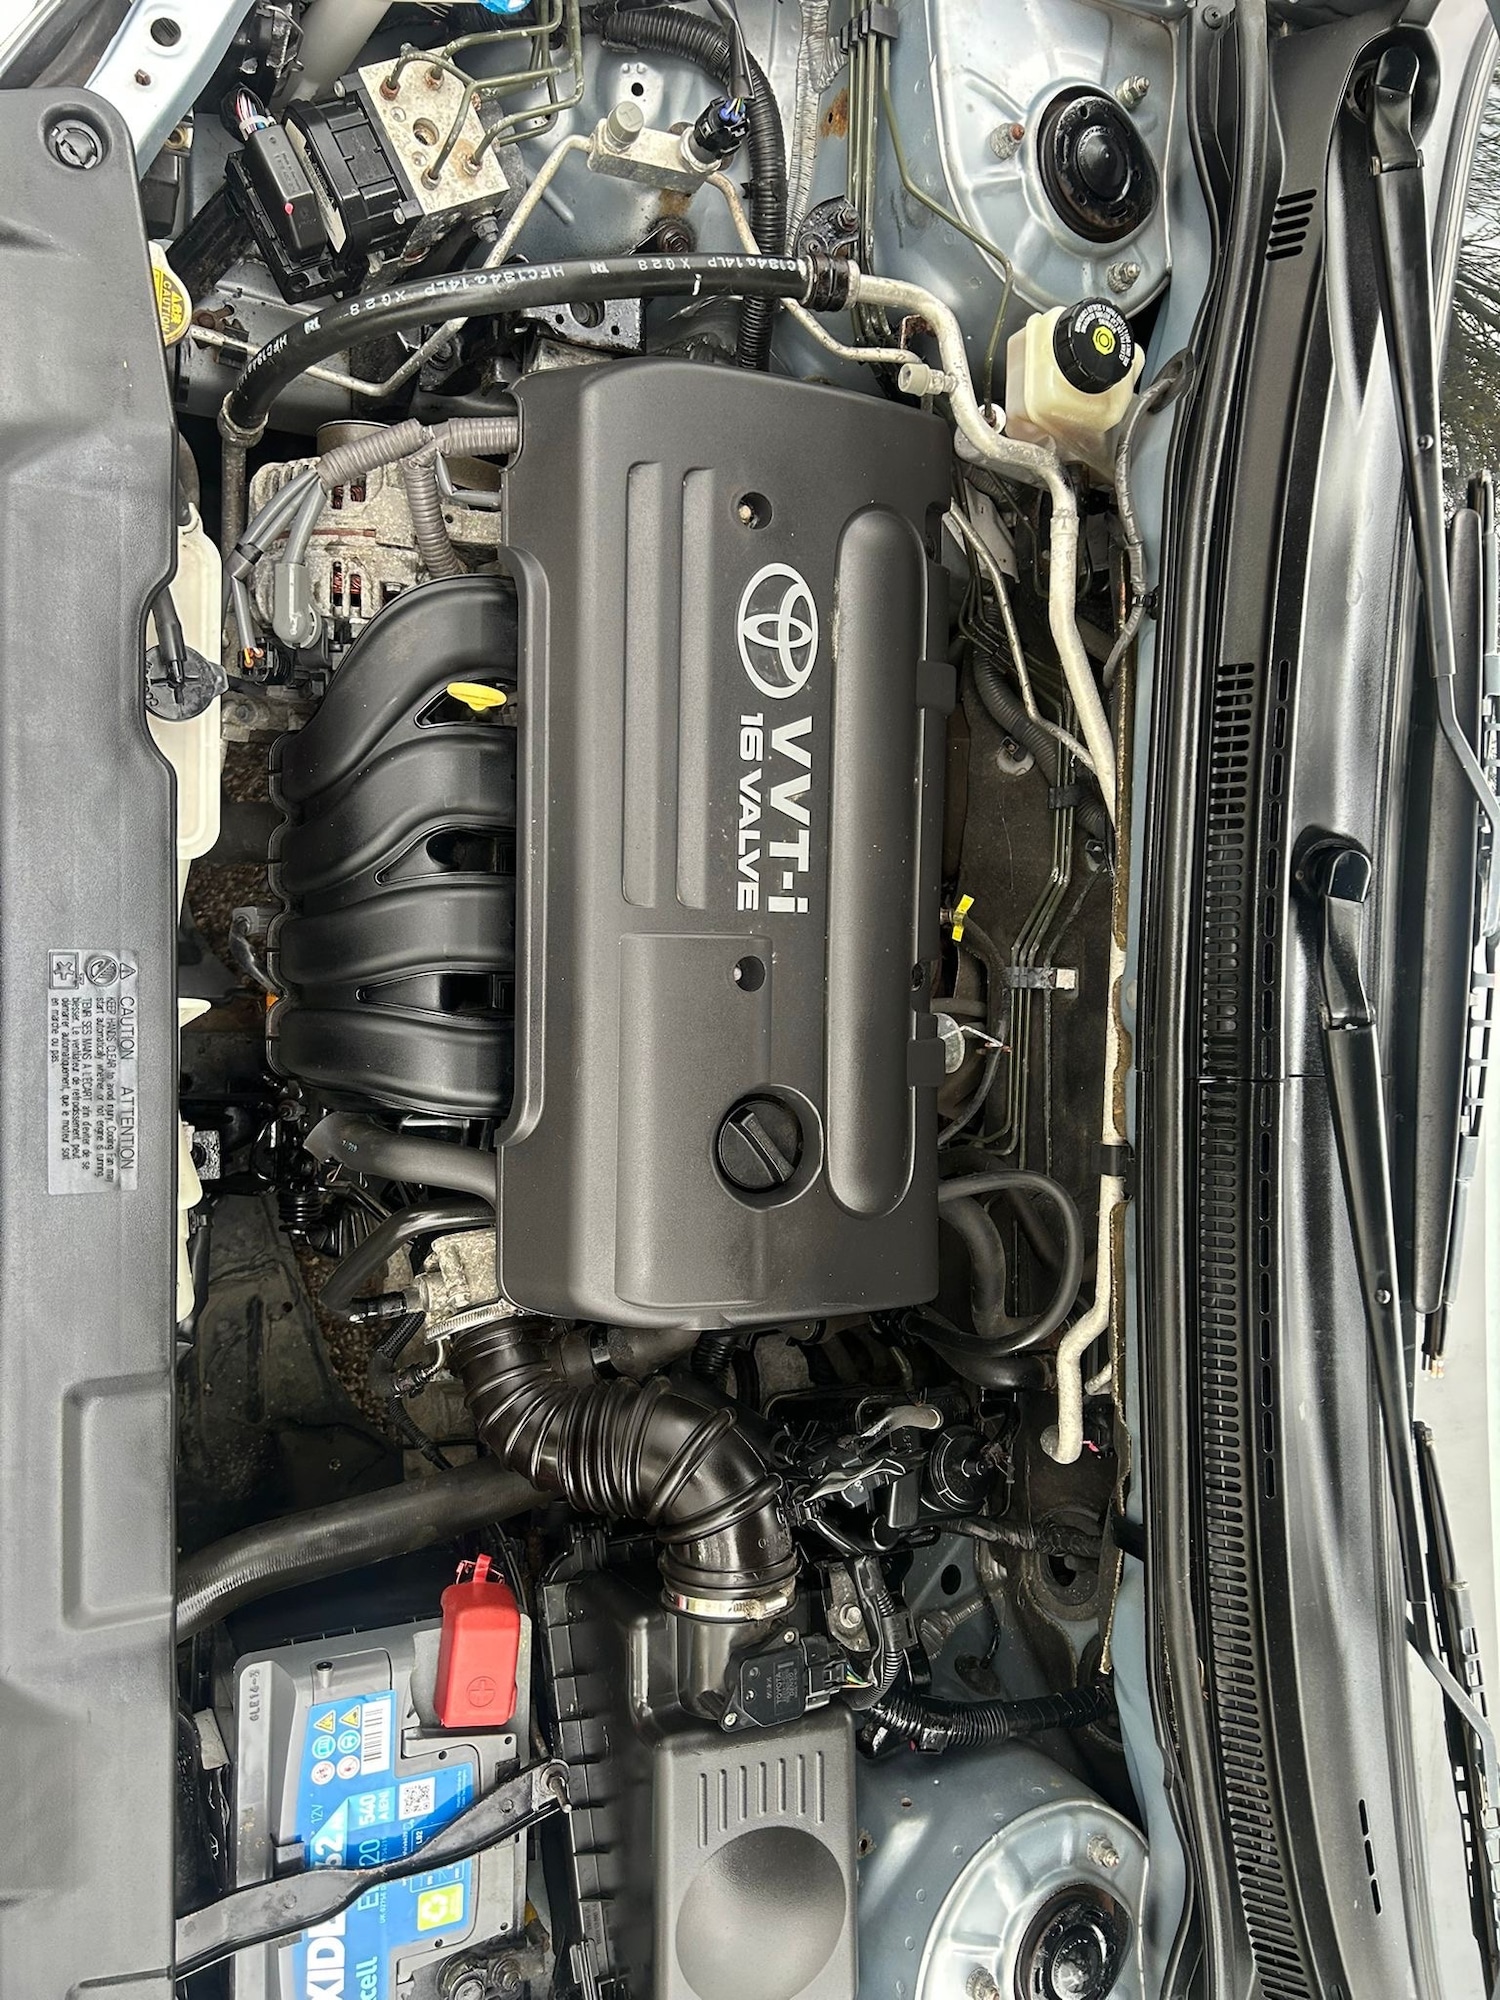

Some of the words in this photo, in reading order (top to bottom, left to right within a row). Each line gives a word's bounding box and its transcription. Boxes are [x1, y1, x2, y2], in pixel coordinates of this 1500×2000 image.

[161, 280, 172, 332] CAUTION
[740, 712, 764, 762] 16
[767, 715, 813, 914] VVT-i
[737, 767, 762, 911] VALVE
[51, 997, 60, 1006] en
[96, 997, 105, 1014] start
[106, 996, 117, 1015] KEEP
[51, 1009, 61, 1035] marche
[82, 1021, 92, 1035] SES
[106, 1018, 117, 1042] HANDS
[120, 996, 135, 1060] CAUTION
[72, 1027, 81, 1035] Le
[51, 1037, 60, 1047] ou
[106, 1045, 117, 1068] CLEAR
[72, 1076, 81, 1085] de
[106, 1072, 116, 1080] to
[60, 1094, 70, 1106] que
[106, 1083, 117, 1101] avoid
[82, 1105, 92, 1118] afin
[96, 1105, 105, 1117] not
[61, 1120, 70, 1143] moteur
[120, 1086, 135, 1170] ATTENTION
[70, 1144, 81, 1160] peut
[82, 1149, 92, 1158] de
[106, 1153, 117, 1166] Fan
[82, 1161, 91, 1170] se
[104, 1169, 114, 1182] may
[311, 1804, 323, 1824] 12V
[358, 1793, 377, 1826] 540
[355, 1957, 378, 2000] cell
